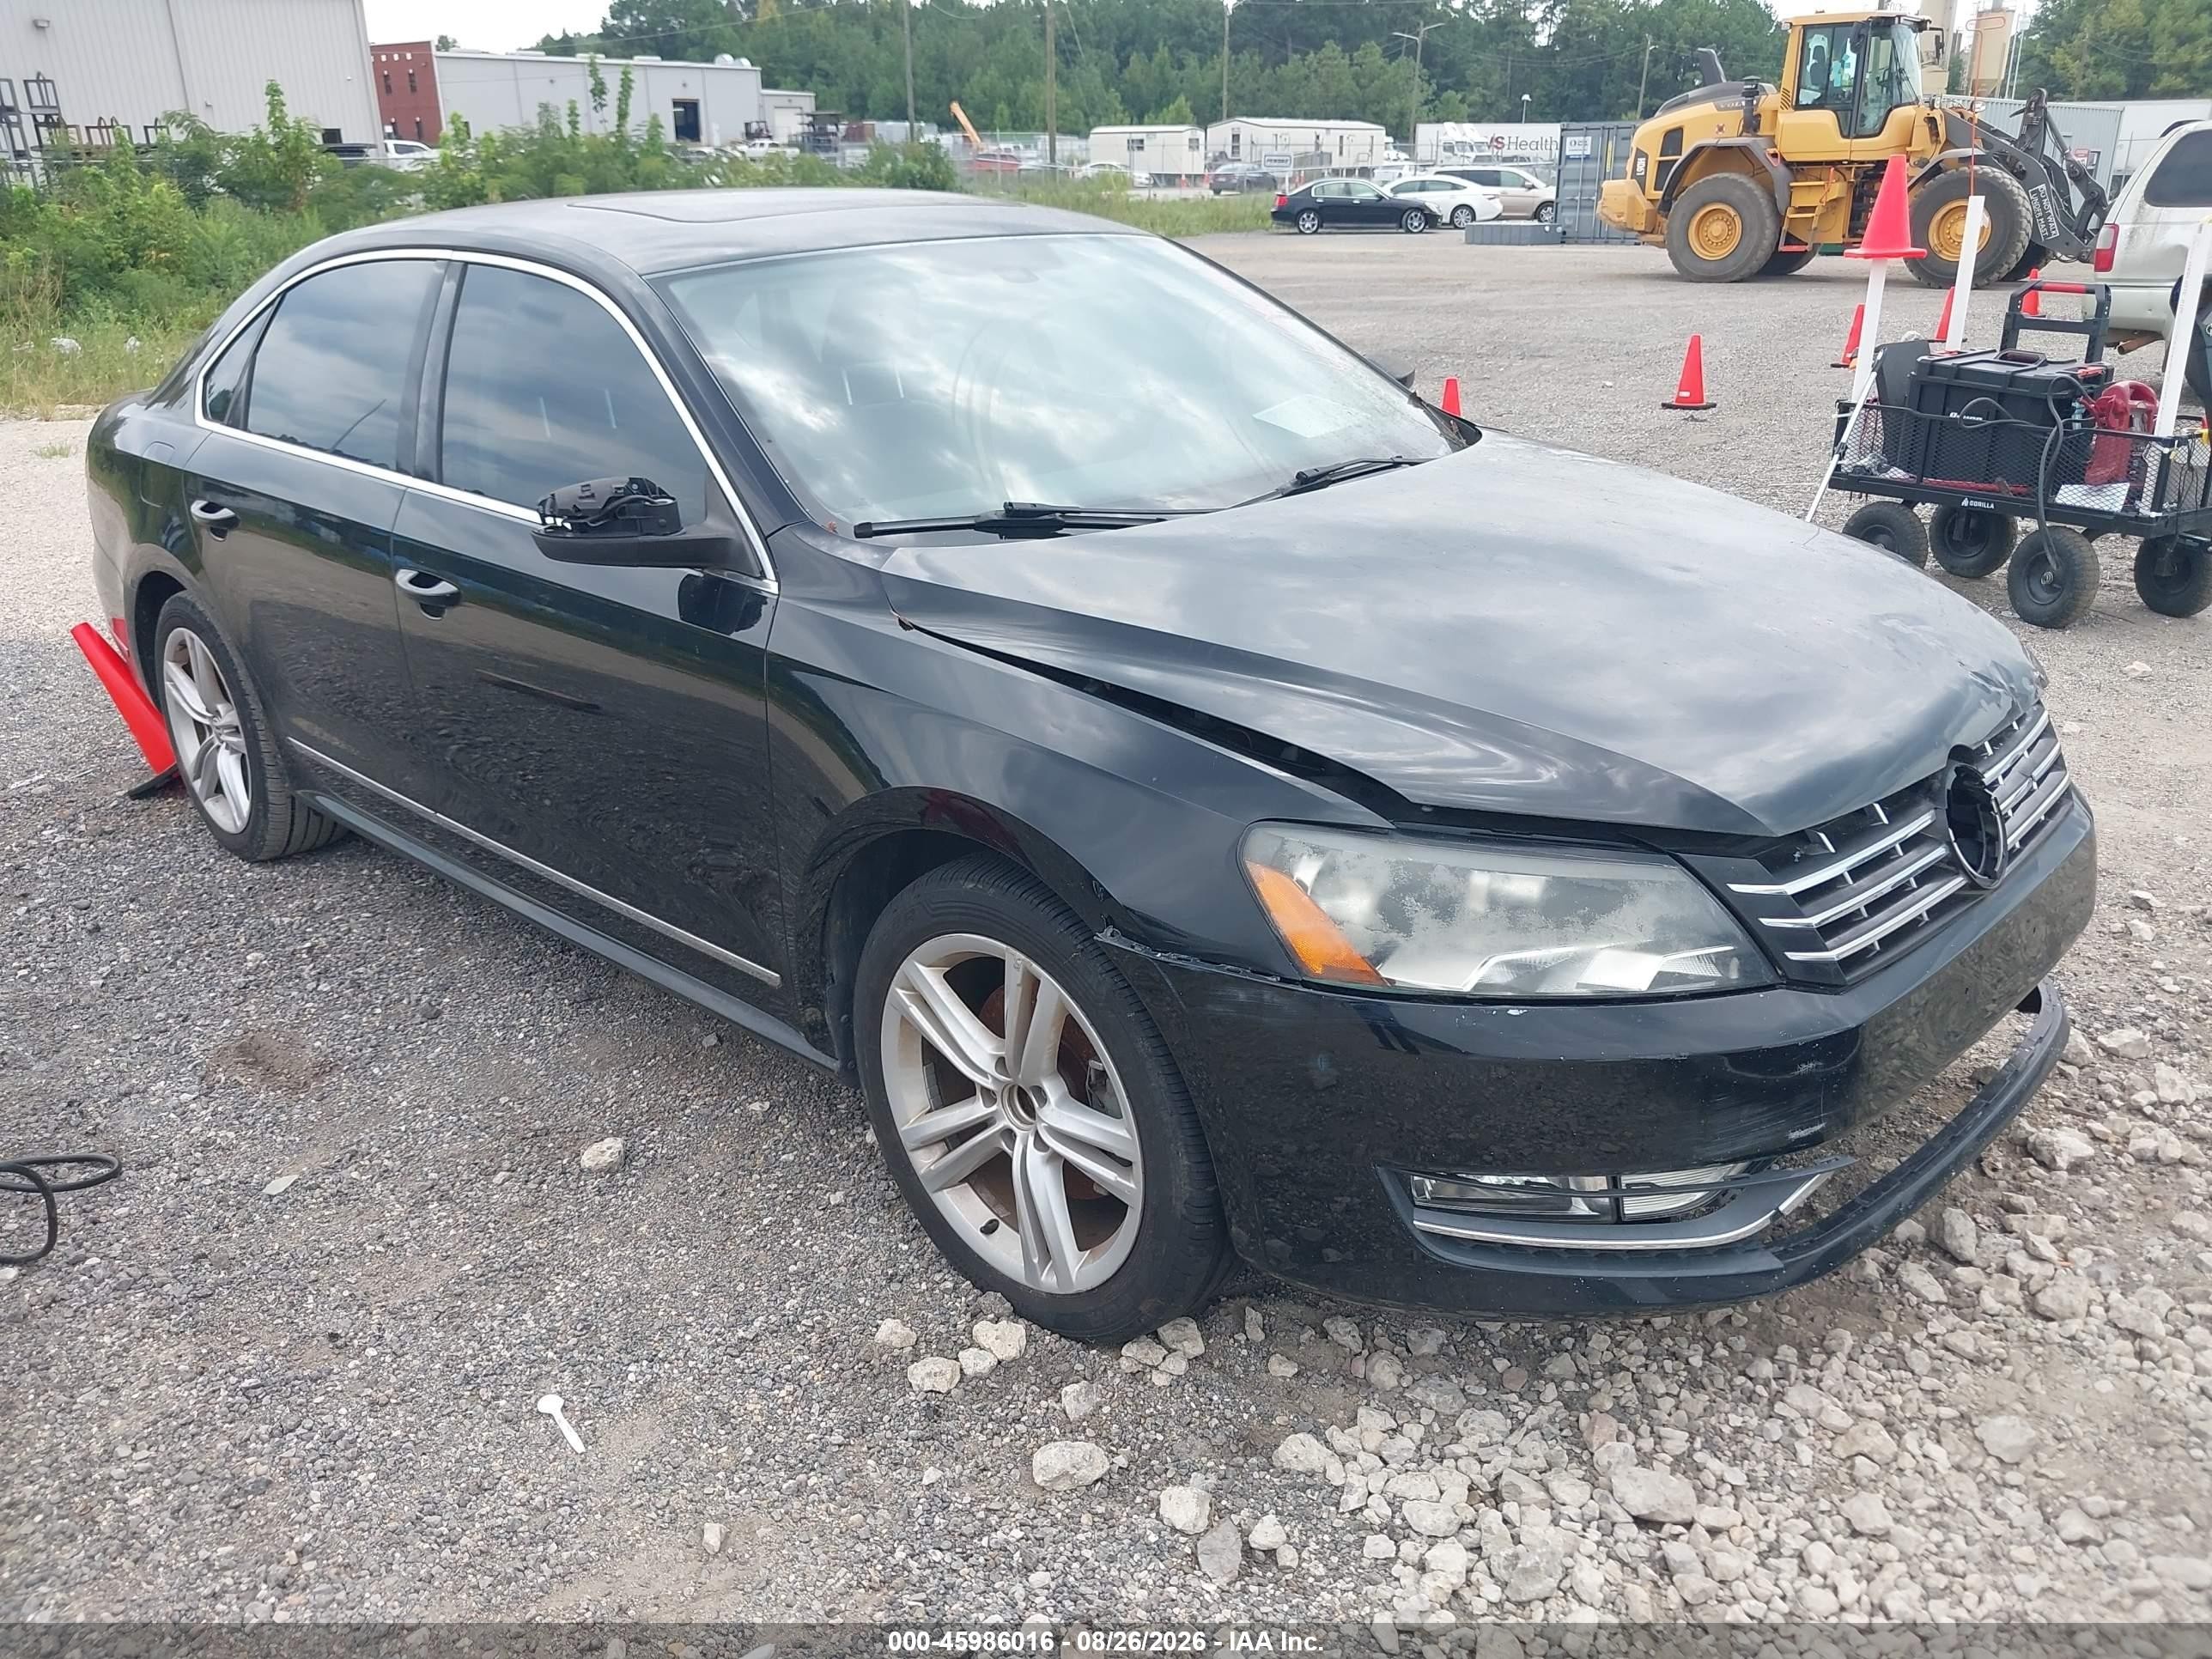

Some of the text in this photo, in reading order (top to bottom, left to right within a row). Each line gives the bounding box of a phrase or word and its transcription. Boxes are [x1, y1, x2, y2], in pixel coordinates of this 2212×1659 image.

[1485, 136, 1505, 150] VS
[1507, 137, 1559, 151] Health
[1636, 158, 1646, 176] L90H
[2032, 193, 2049, 236] UNDER MAST
[2038, 186, 2058, 237] DO NOT WALK
[1969, 500, 1995, 509] GORILLA
